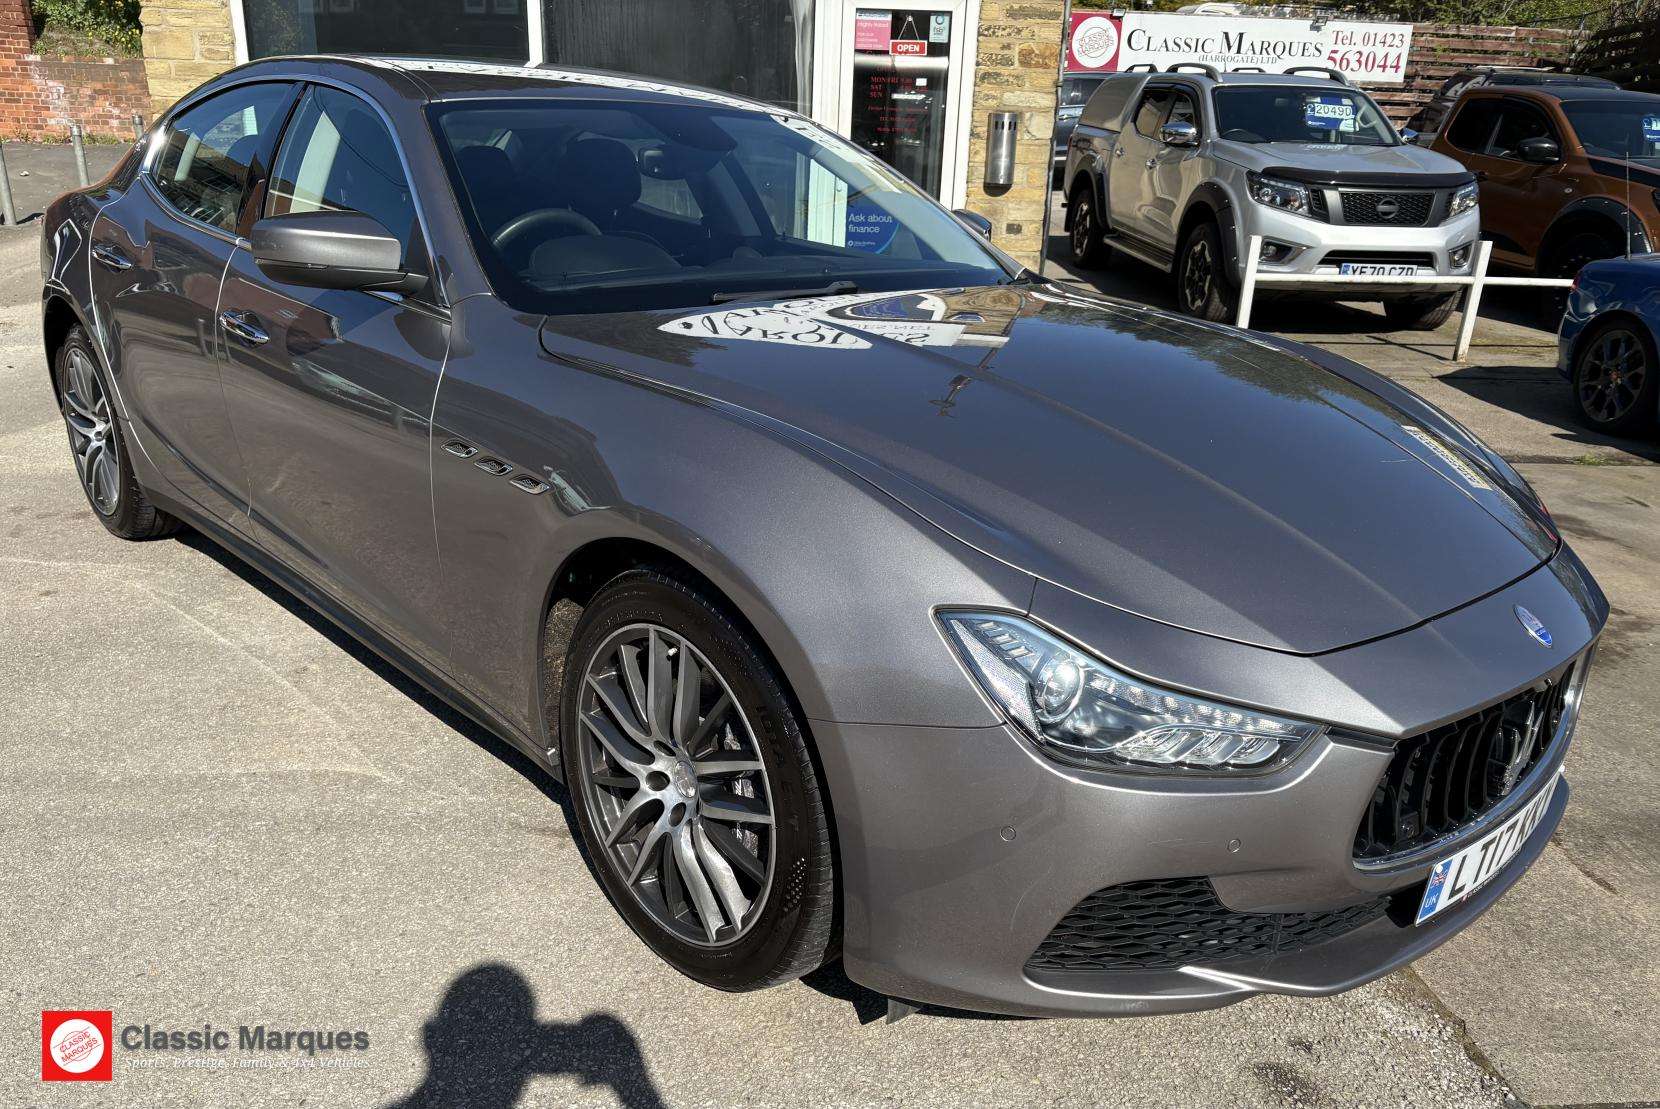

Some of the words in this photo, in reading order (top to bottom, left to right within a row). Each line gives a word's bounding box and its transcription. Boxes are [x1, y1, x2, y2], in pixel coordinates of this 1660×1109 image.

[1127, 28, 1215, 54] CLASSIC
[1219, 31, 1324, 59] MARQUES
[1333, 30, 1356, 46] Tel.
[1362, 31, 1405, 48] 01423
[897, 44, 920, 52] OPEN
[1327, 49, 1402, 73] 563044
[848, 213, 866, 223] Ask
[848, 224, 881, 233] finance
[1424, 893, 1438, 909] UK
